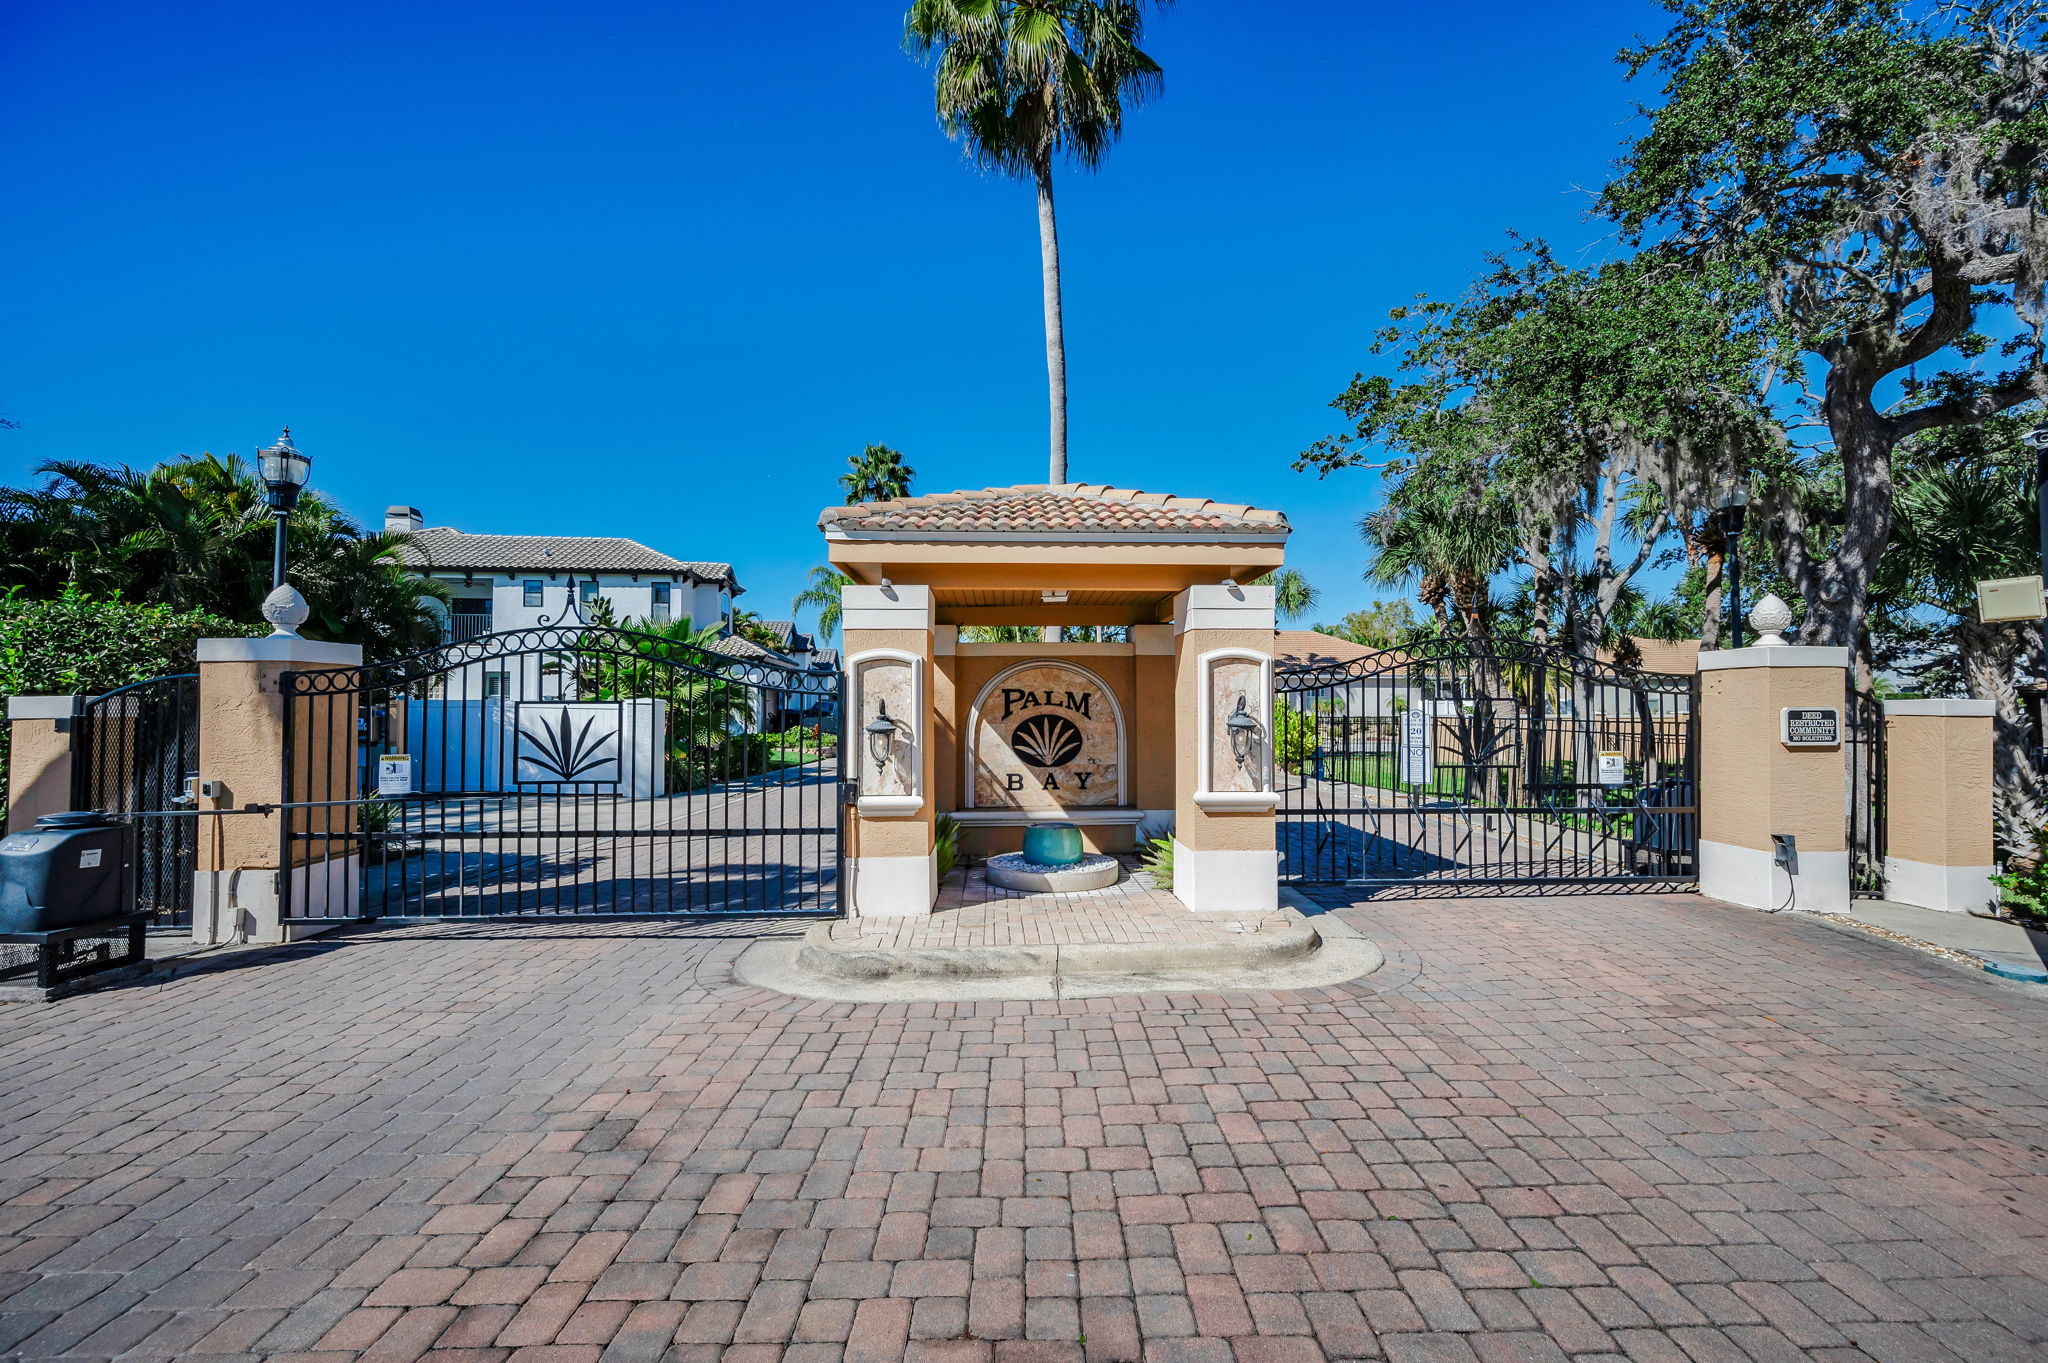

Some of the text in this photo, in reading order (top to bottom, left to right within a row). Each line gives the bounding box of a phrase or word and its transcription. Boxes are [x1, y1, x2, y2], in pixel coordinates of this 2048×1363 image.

[1001, 688, 1092, 721] PALM
[1801, 711, 1823, 720] DEED
[1790, 719, 1835, 727] RESTRICTED
[1410, 727, 1422, 735] 20
[1790, 726, 1836, 734] COMMUNITY
[1409, 749, 1424, 757] NO
[1005, 772, 1092, 791] BAY
